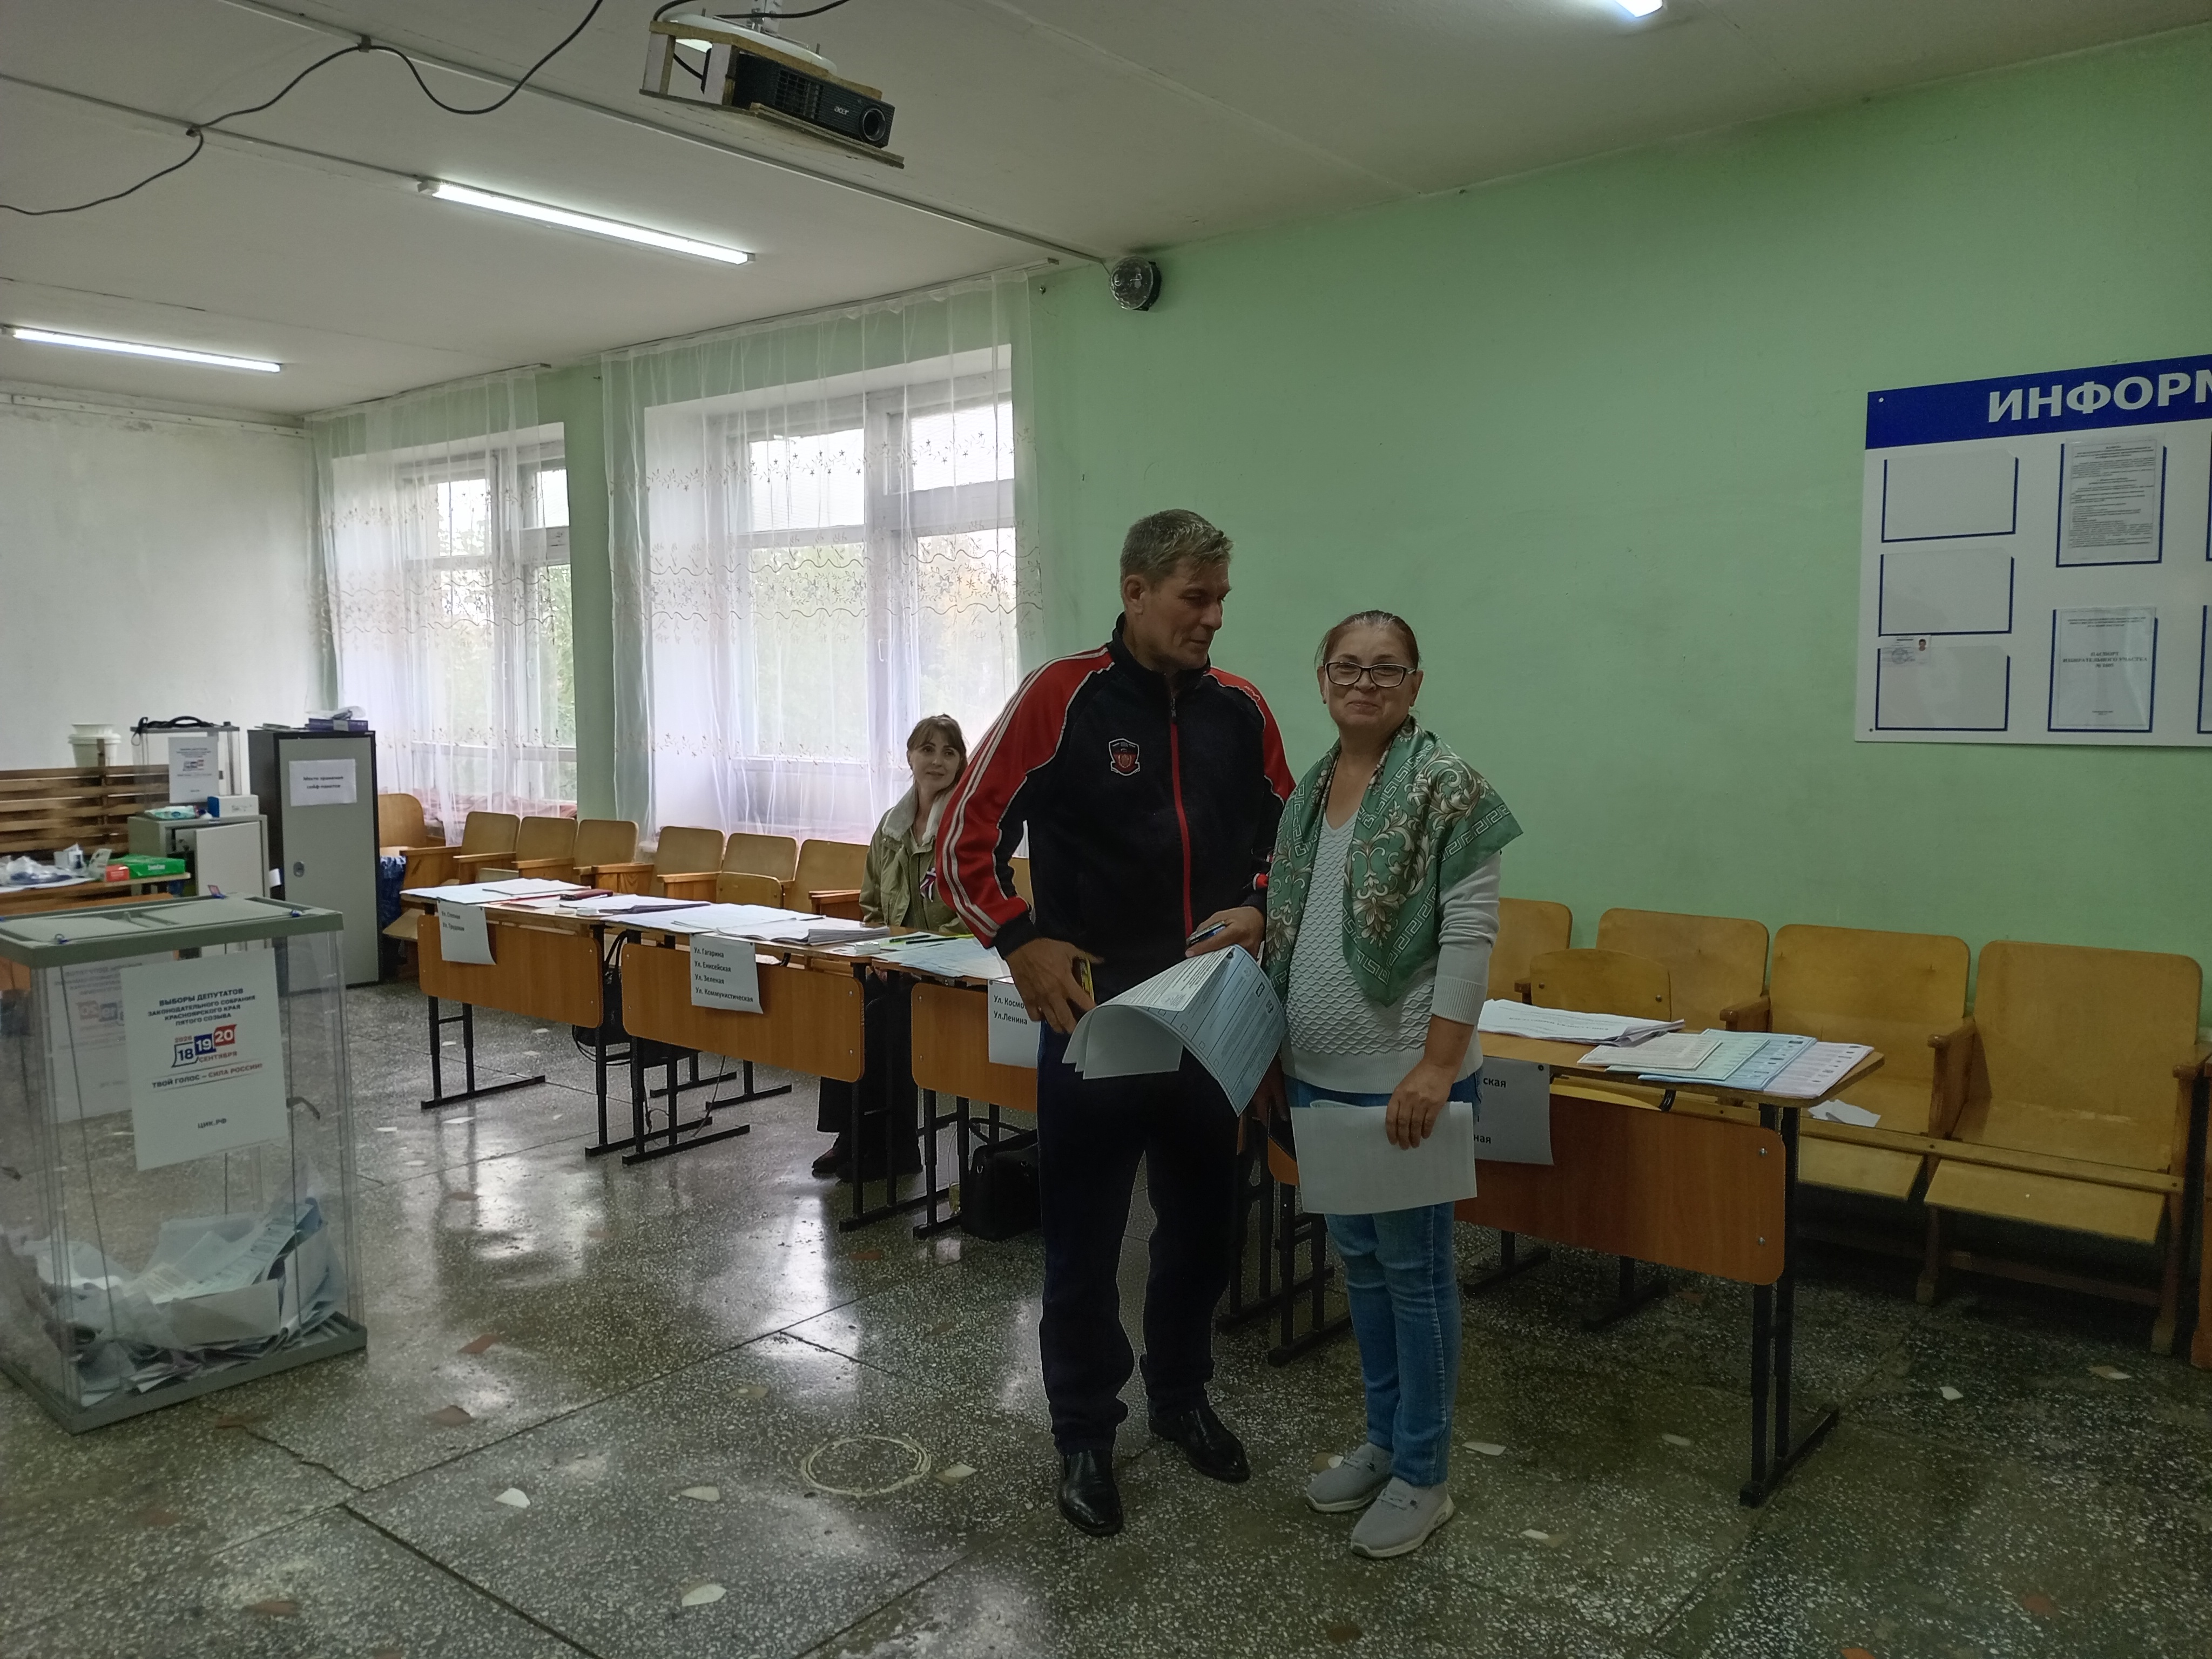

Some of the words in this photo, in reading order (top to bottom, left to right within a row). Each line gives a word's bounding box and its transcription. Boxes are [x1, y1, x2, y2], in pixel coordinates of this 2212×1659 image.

[834, 106, 849, 115] acer
[702, 948, 724, 958] Гагарина
[703, 961, 731, 972] Енисейская
[704, 975, 724, 984] Зеленая
[159, 995, 195, 1007] ВЫБОРЫ
[197, 988, 244, 1001] ДЕПУТАТОВ
[704, 988, 753, 1002] Коммунистическая
[994, 994, 1003, 1004] Ул.
[147, 1001, 220, 1016] ЗАКОНОДАТЕЛЬНОГО
[220, 995, 256, 1006] СОБРАНИЯ
[164, 1008, 222, 1021] КРАСНОЯРСКОГО
[176, 1017, 203, 1026] ПЯТОГО
[204, 1013, 232, 1022] СОЗЫВА
[994, 1010, 1028, 1025] Ул.Ленина
[215, 1029, 233, 1043] 20
[196, 1038, 212, 1051] 19
[178, 1048, 193, 1061] 18
[199, 1051, 238, 1063] СЕНТЯБРЯ
[152, 1079, 173, 1088] ТВОЙ
[174, 1075, 200, 1083] ГОЛОС
[198, 1118, 227, 1129] ЦИК.РФ
